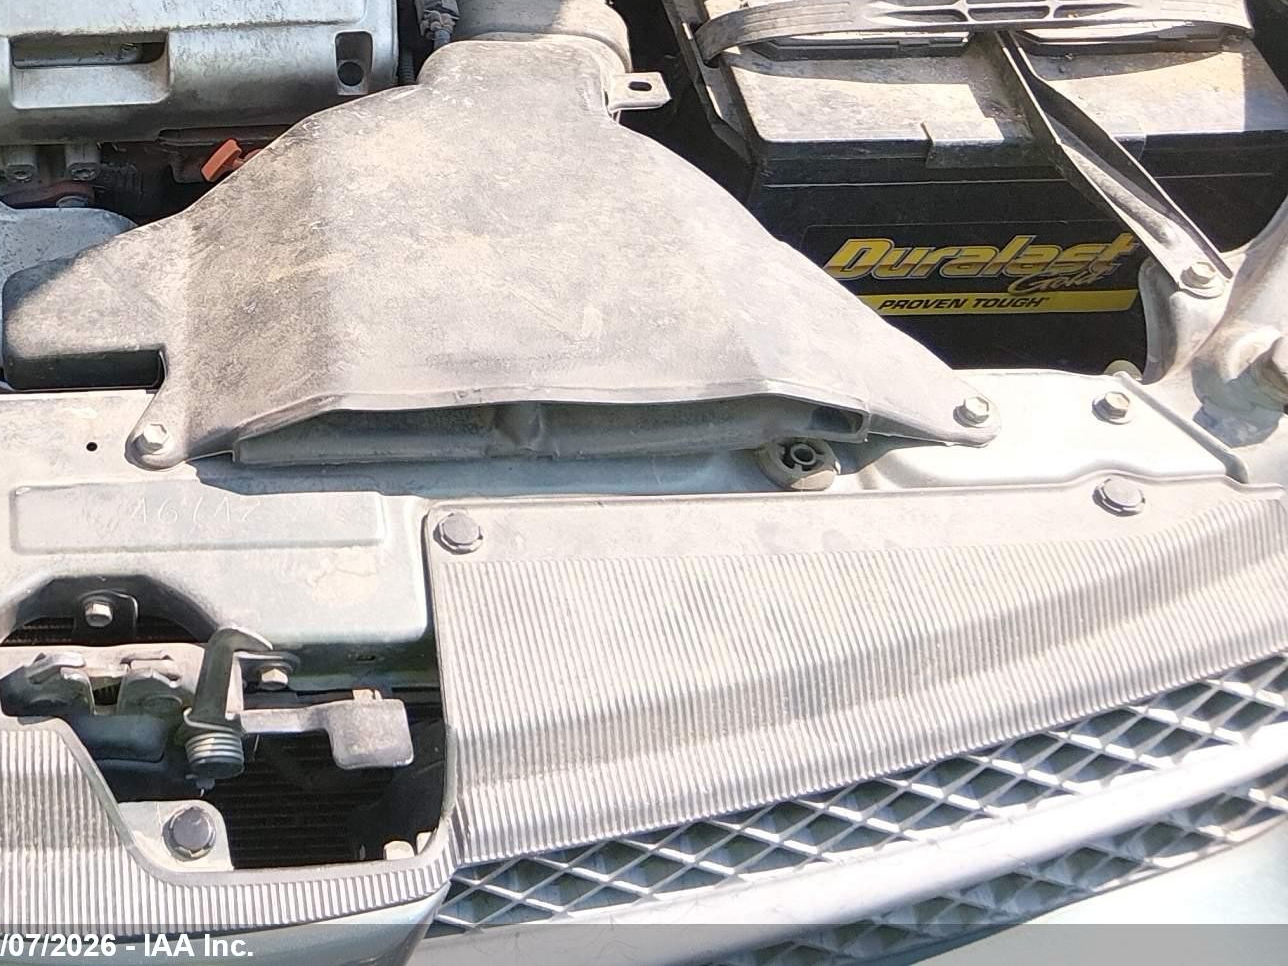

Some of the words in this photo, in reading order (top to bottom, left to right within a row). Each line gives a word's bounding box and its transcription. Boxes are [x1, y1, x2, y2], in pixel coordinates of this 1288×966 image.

[822, 233, 1142, 281] Duralast
[1007, 263, 1121, 296] Gold
[878, 297, 967, 311] PROVEN
